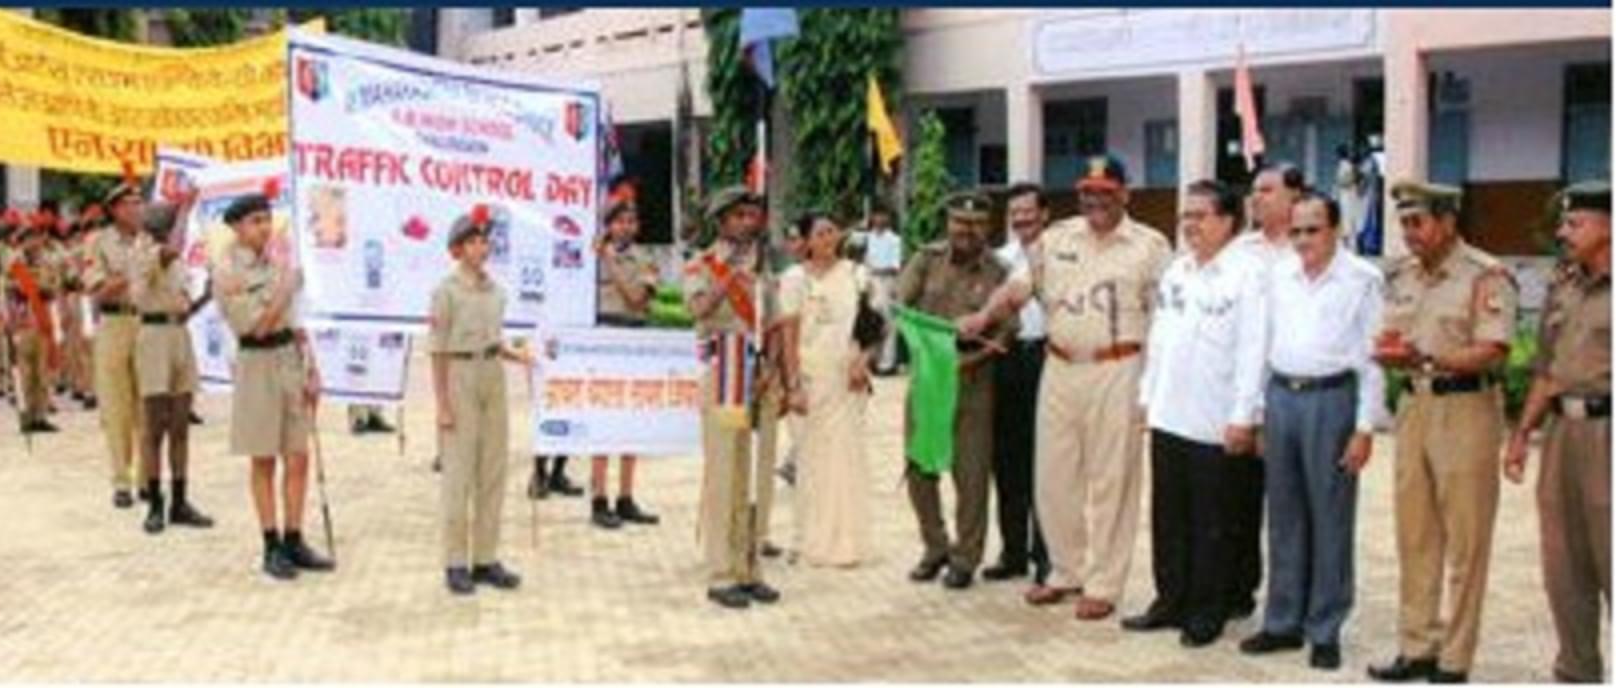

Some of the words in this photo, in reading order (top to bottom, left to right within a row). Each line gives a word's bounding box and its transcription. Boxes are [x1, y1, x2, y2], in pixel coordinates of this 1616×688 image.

[462, 117, 515, 142] SCHOOL
[293, 142, 411, 187] TRAFFIC
[419, 154, 536, 201] CONTROL
[544, 171, 593, 208] DAY
